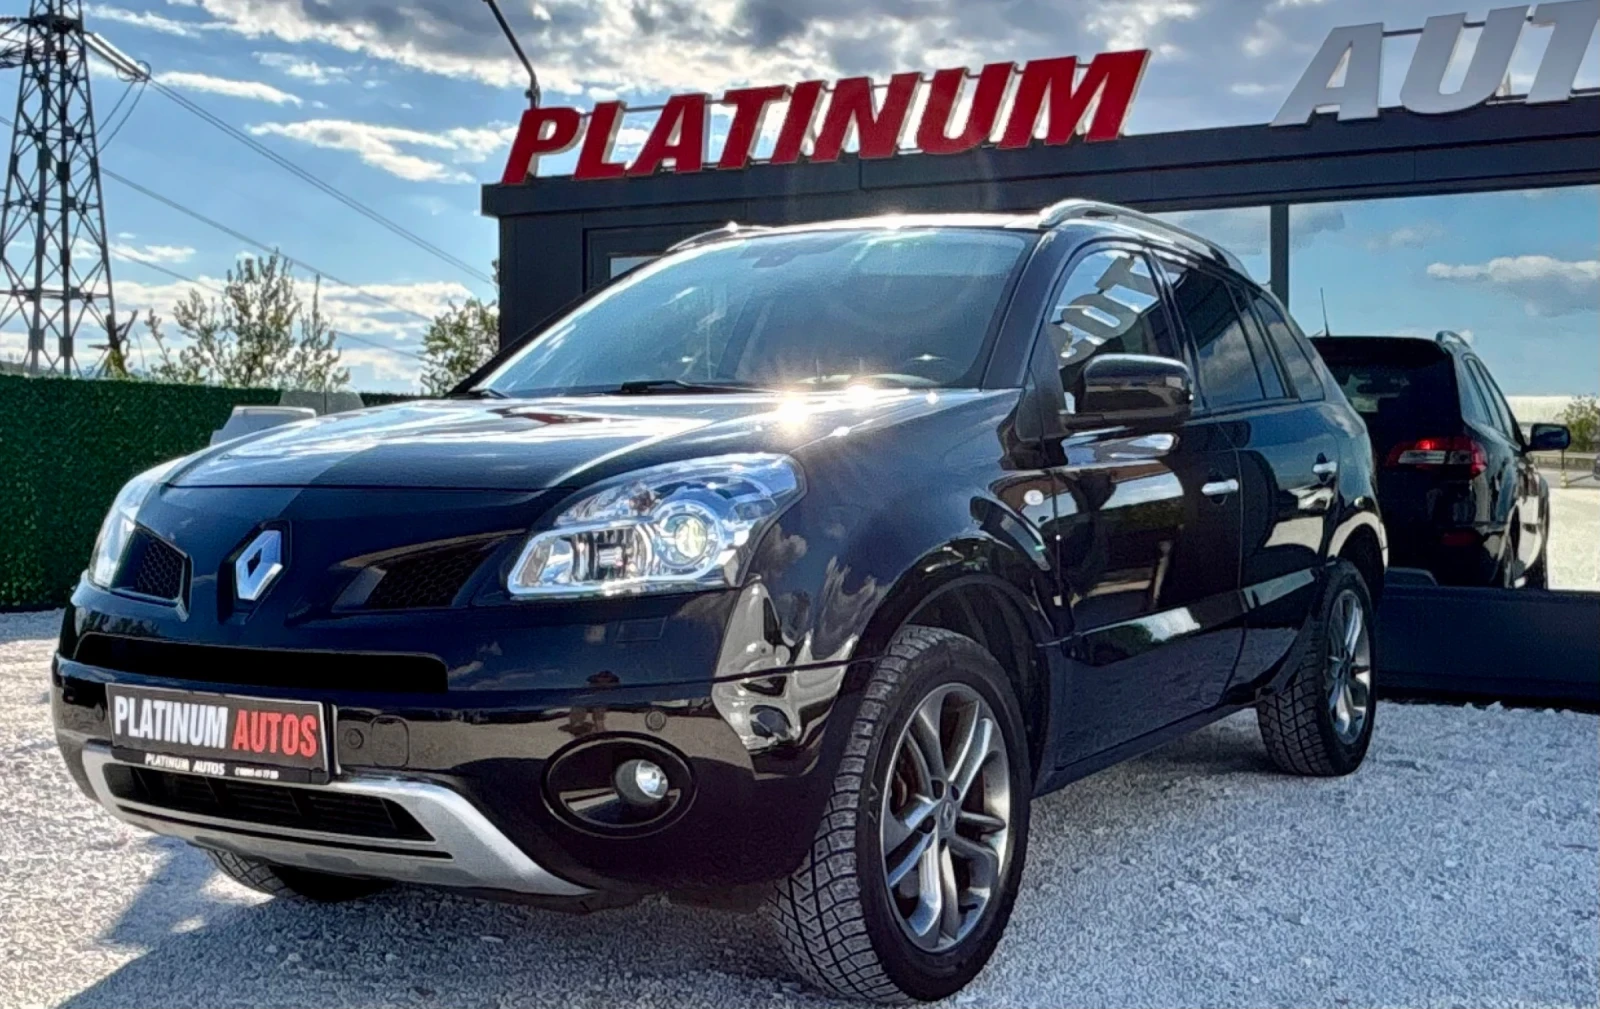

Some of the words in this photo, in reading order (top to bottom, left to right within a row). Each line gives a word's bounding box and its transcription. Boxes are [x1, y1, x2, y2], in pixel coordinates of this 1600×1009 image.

[502, 49, 1151, 185] PLATINUM
[1269, 0, 1600, 127] AUT
[114, 696, 228, 749] PLATINUM
[232, 709, 317, 758] AUTOS
[145, 753, 189, 771] PLATINUM
[193, 760, 225, 776] AUTOS
